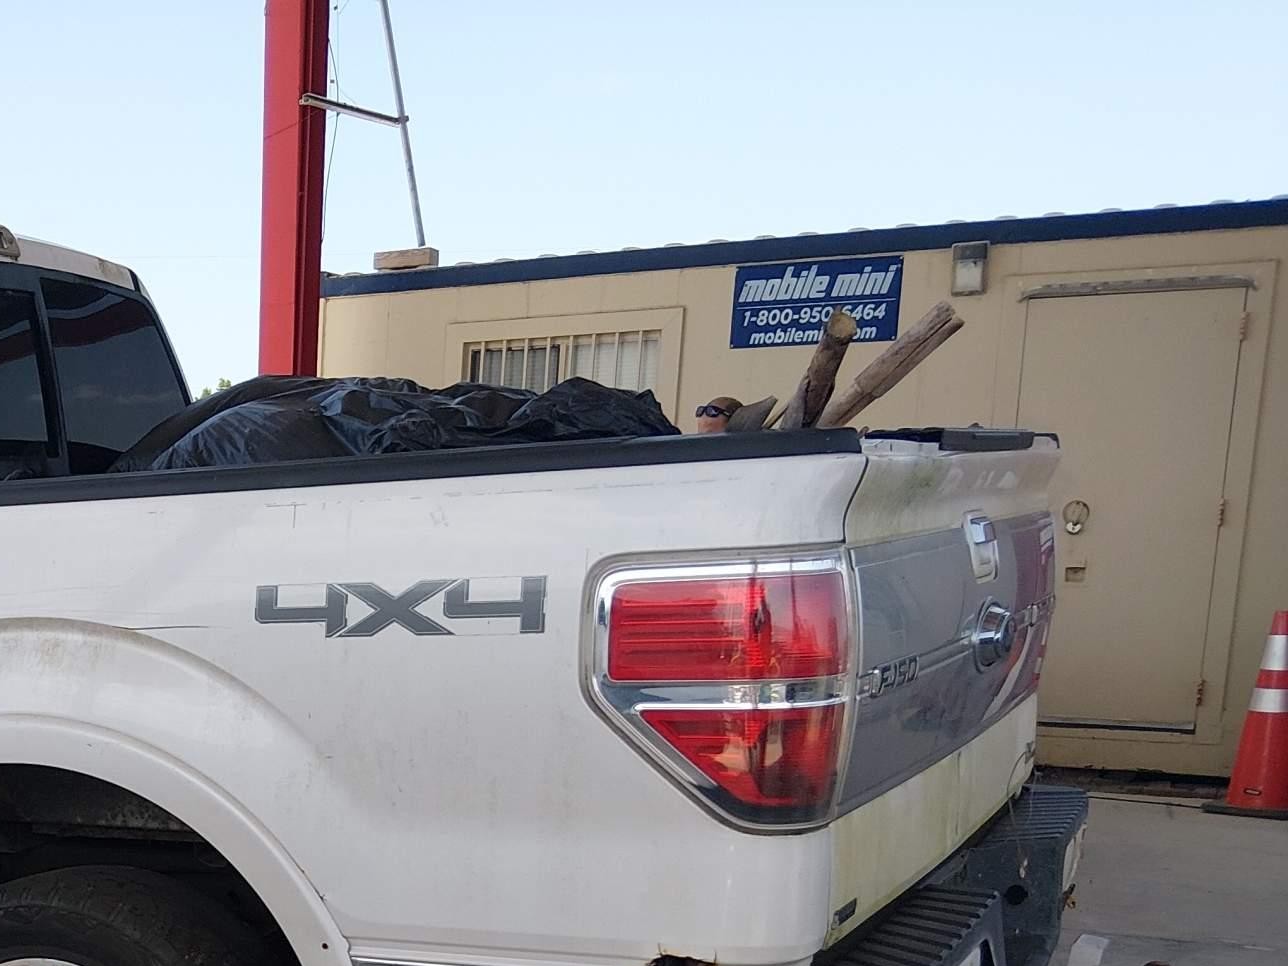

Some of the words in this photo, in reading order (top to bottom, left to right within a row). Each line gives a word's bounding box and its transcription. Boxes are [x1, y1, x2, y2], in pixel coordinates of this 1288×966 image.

[738, 265, 830, 303] mobile
[830, 264, 897, 298] mini
[743, 303, 887, 327] 1-800-9506464
